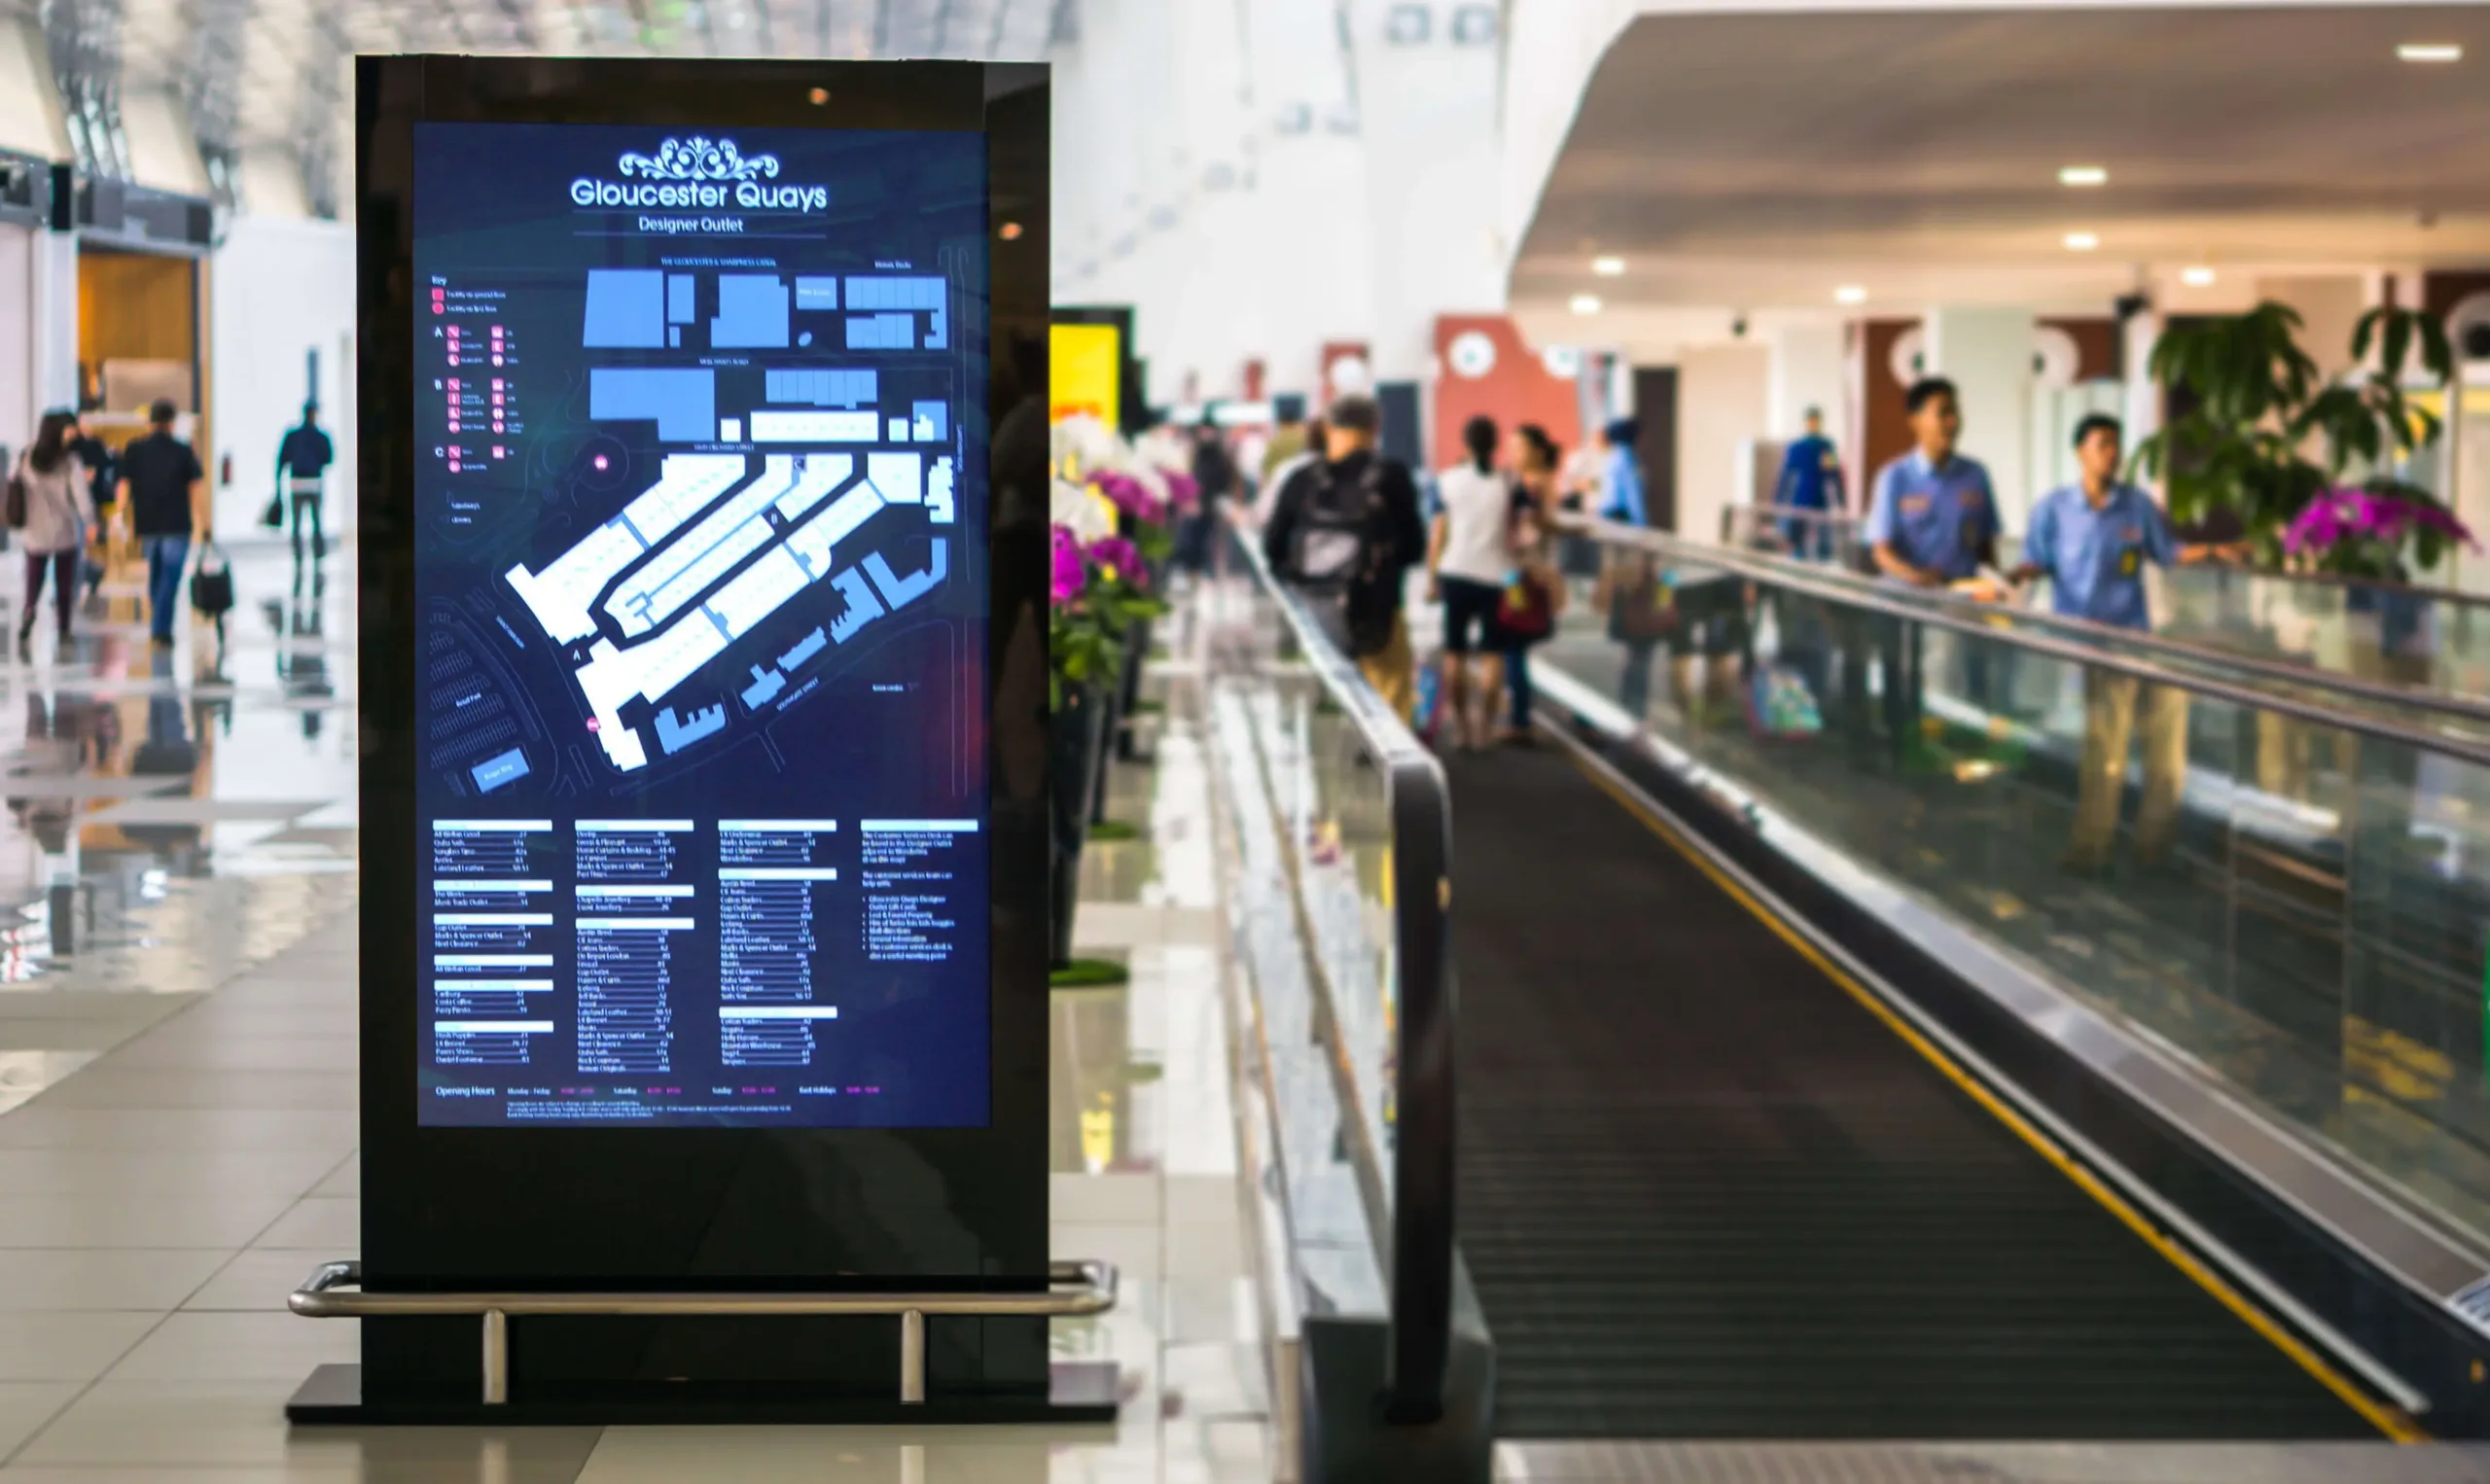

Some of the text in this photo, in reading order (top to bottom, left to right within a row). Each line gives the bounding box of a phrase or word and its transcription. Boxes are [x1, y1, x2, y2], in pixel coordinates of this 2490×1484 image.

[572, 179, 827, 213] Gloucester Quays
[639, 217, 743, 233] Designer Outlet
[432, 276, 446, 287] Key
[435, 326, 443, 337] A
[573, 650, 581, 660] A
[436, 1086, 495, 1097] Opening Hours
